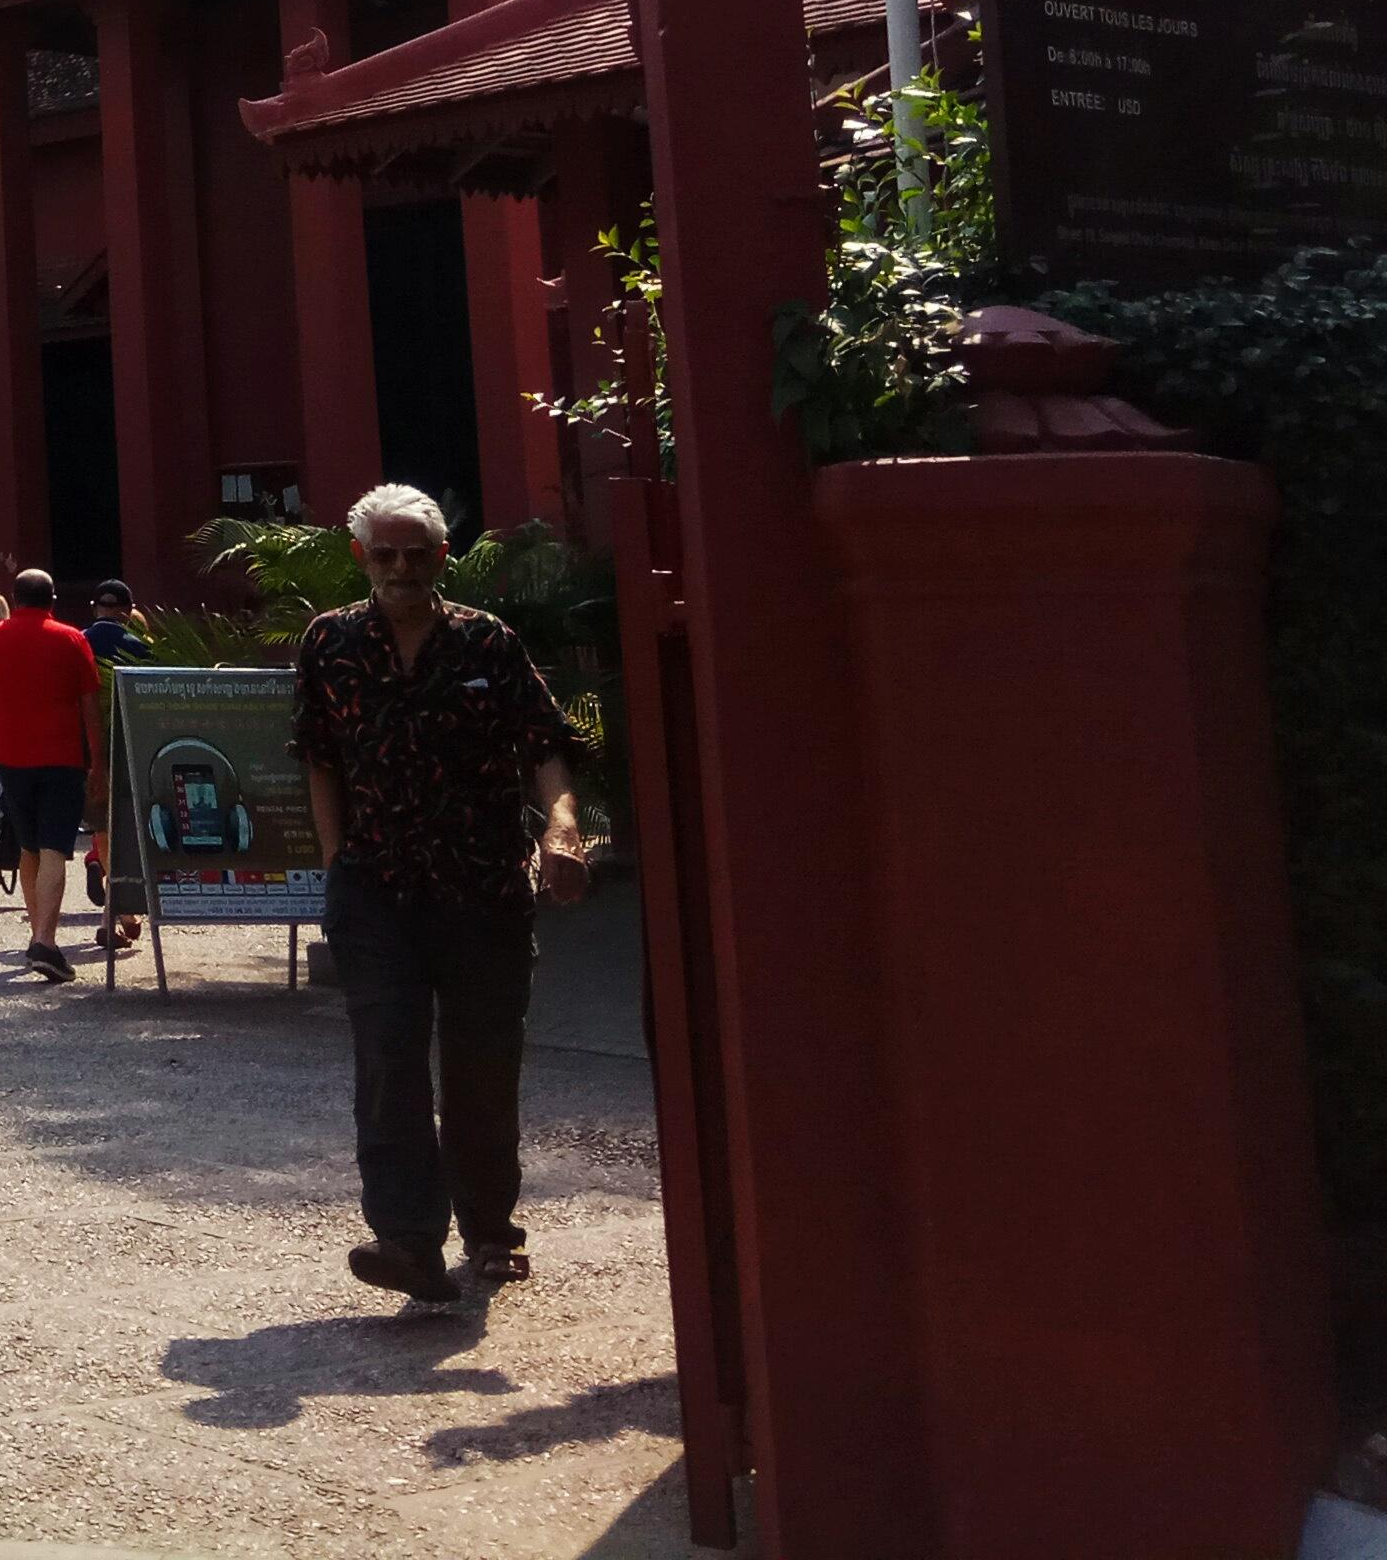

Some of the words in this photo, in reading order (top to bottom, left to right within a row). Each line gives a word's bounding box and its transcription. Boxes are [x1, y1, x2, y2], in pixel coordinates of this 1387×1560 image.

[1043, 0, 1096, 22] OUVERT
[1097, 7, 1129, 28] TOUS
[1131, 14, 1154, 32] LES
[1157, 18, 1199, 38] JOURS
[1118, 98, 1142, 116] USD
